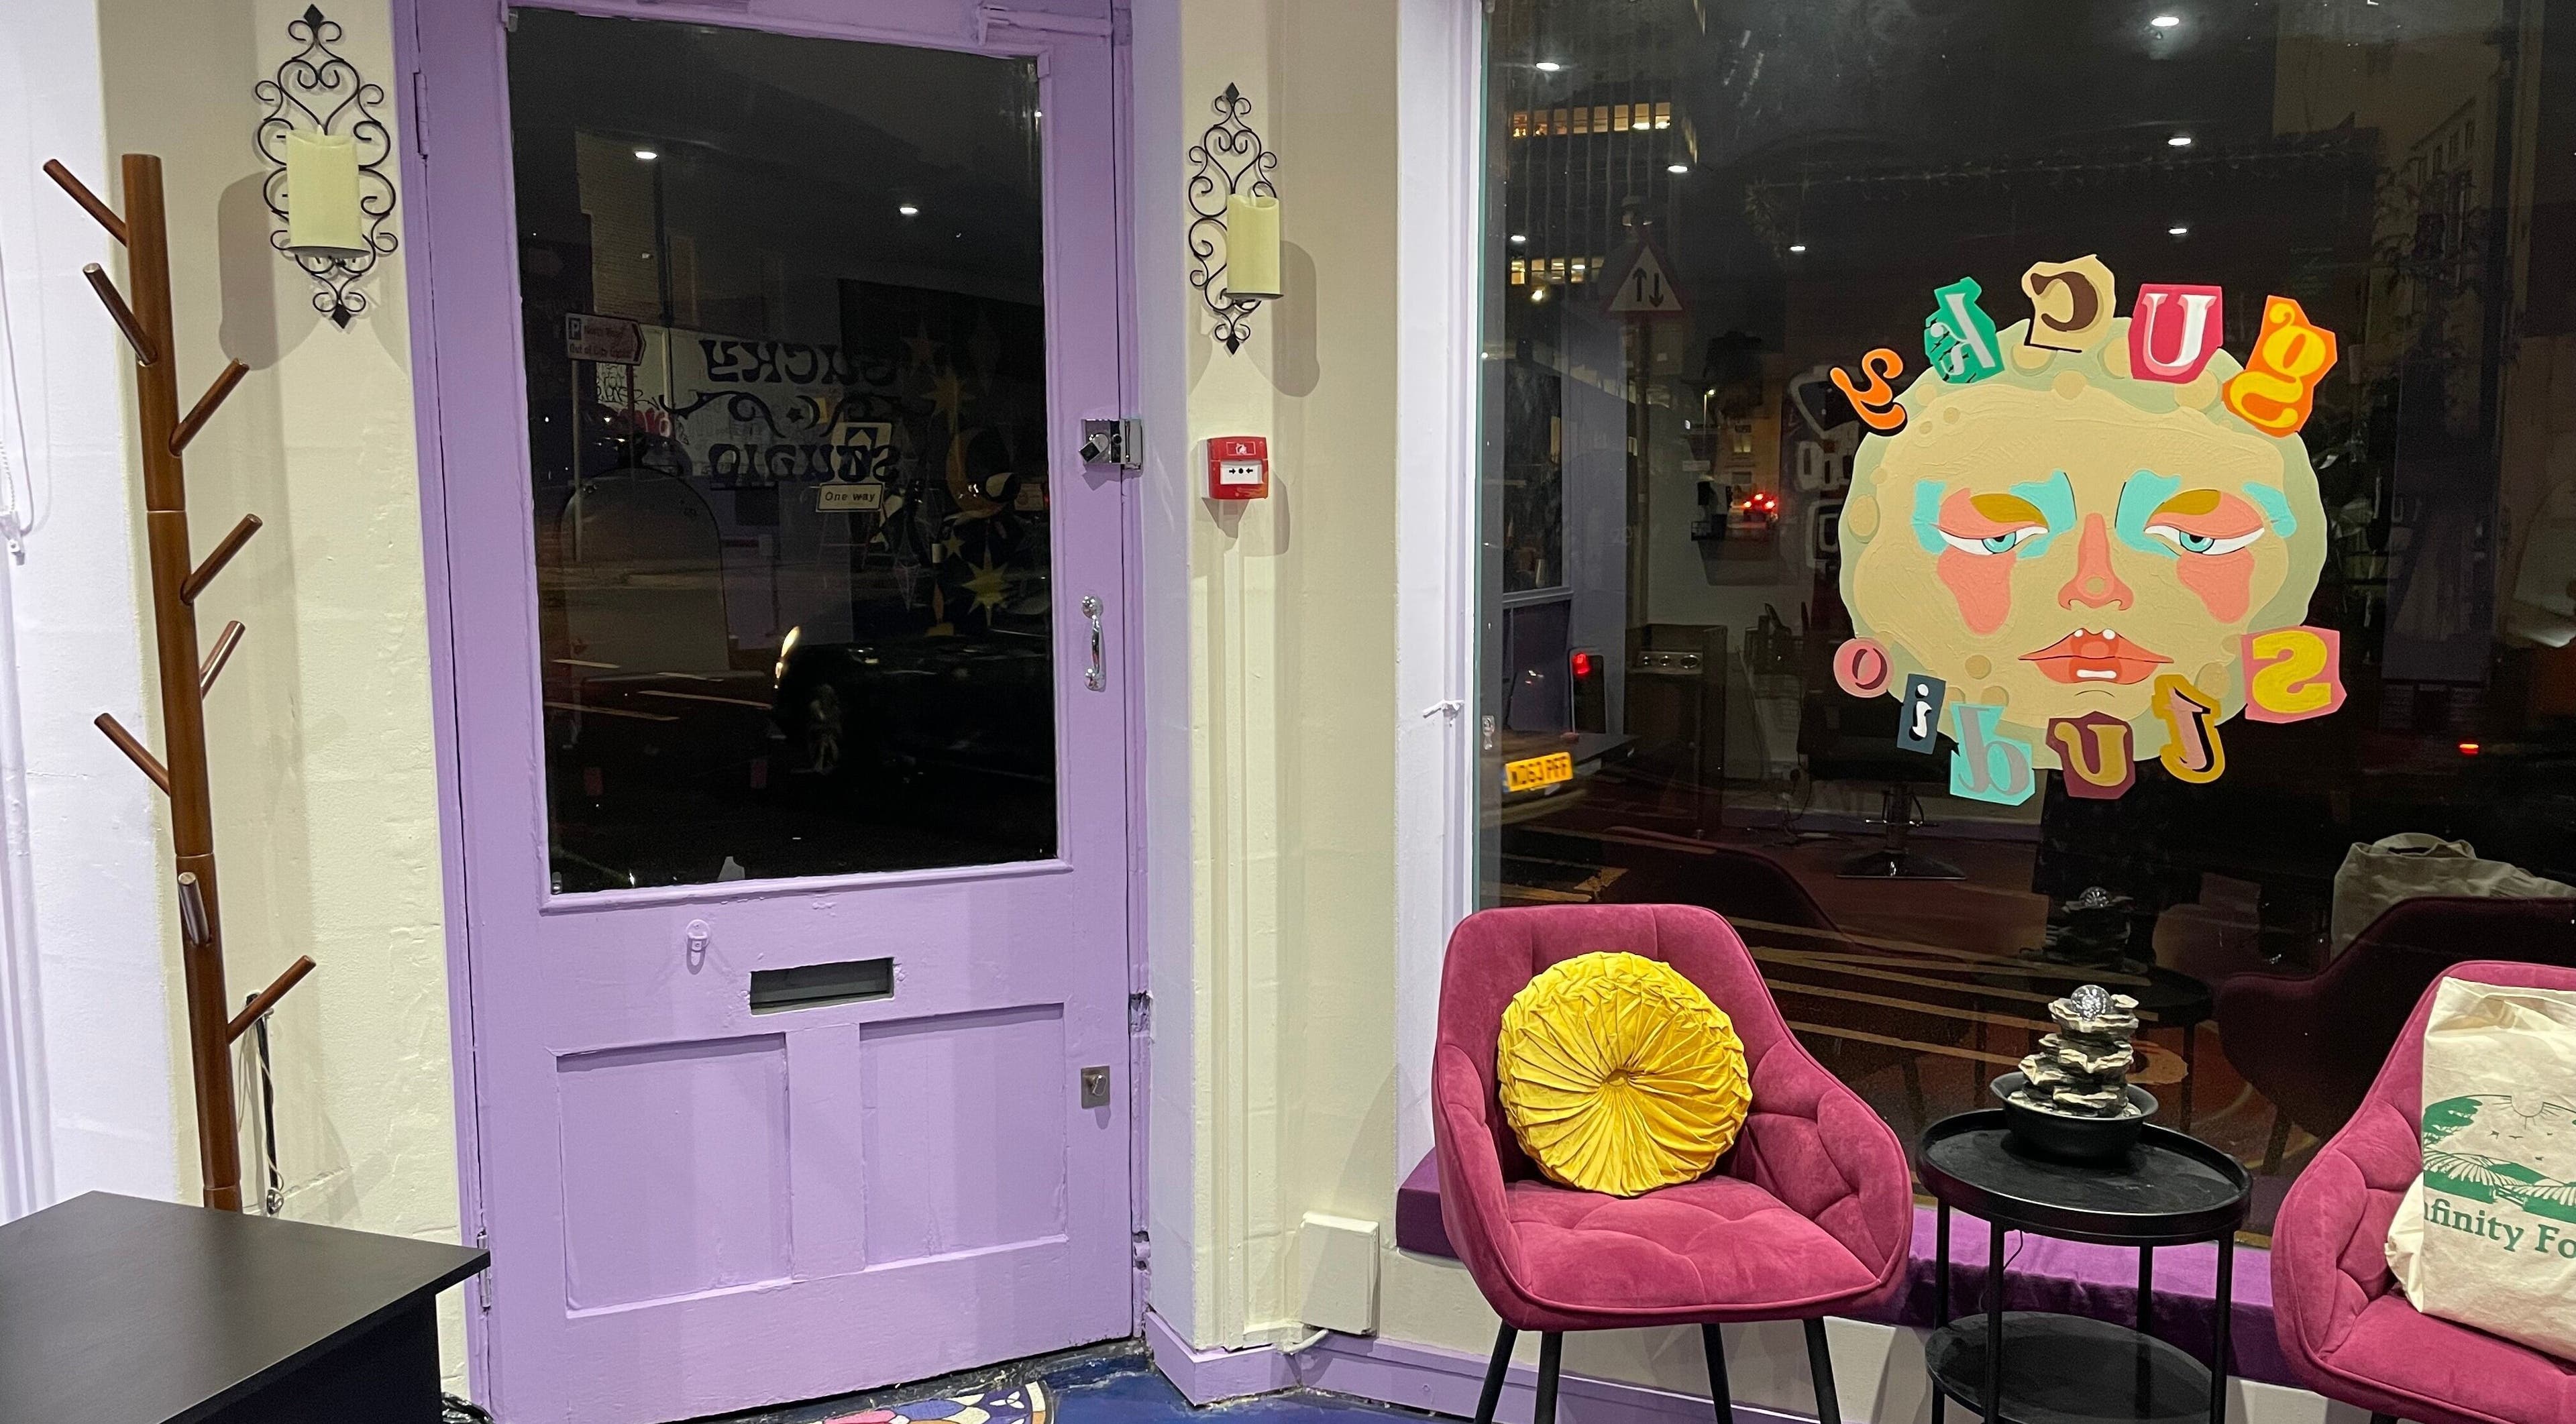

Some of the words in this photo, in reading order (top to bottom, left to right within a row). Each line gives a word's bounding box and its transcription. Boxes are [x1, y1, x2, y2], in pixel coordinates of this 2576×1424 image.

[825, 490, 847, 502] One
[853, 492, 875, 502] way
[2424, 1199, 2524, 1252] finity
